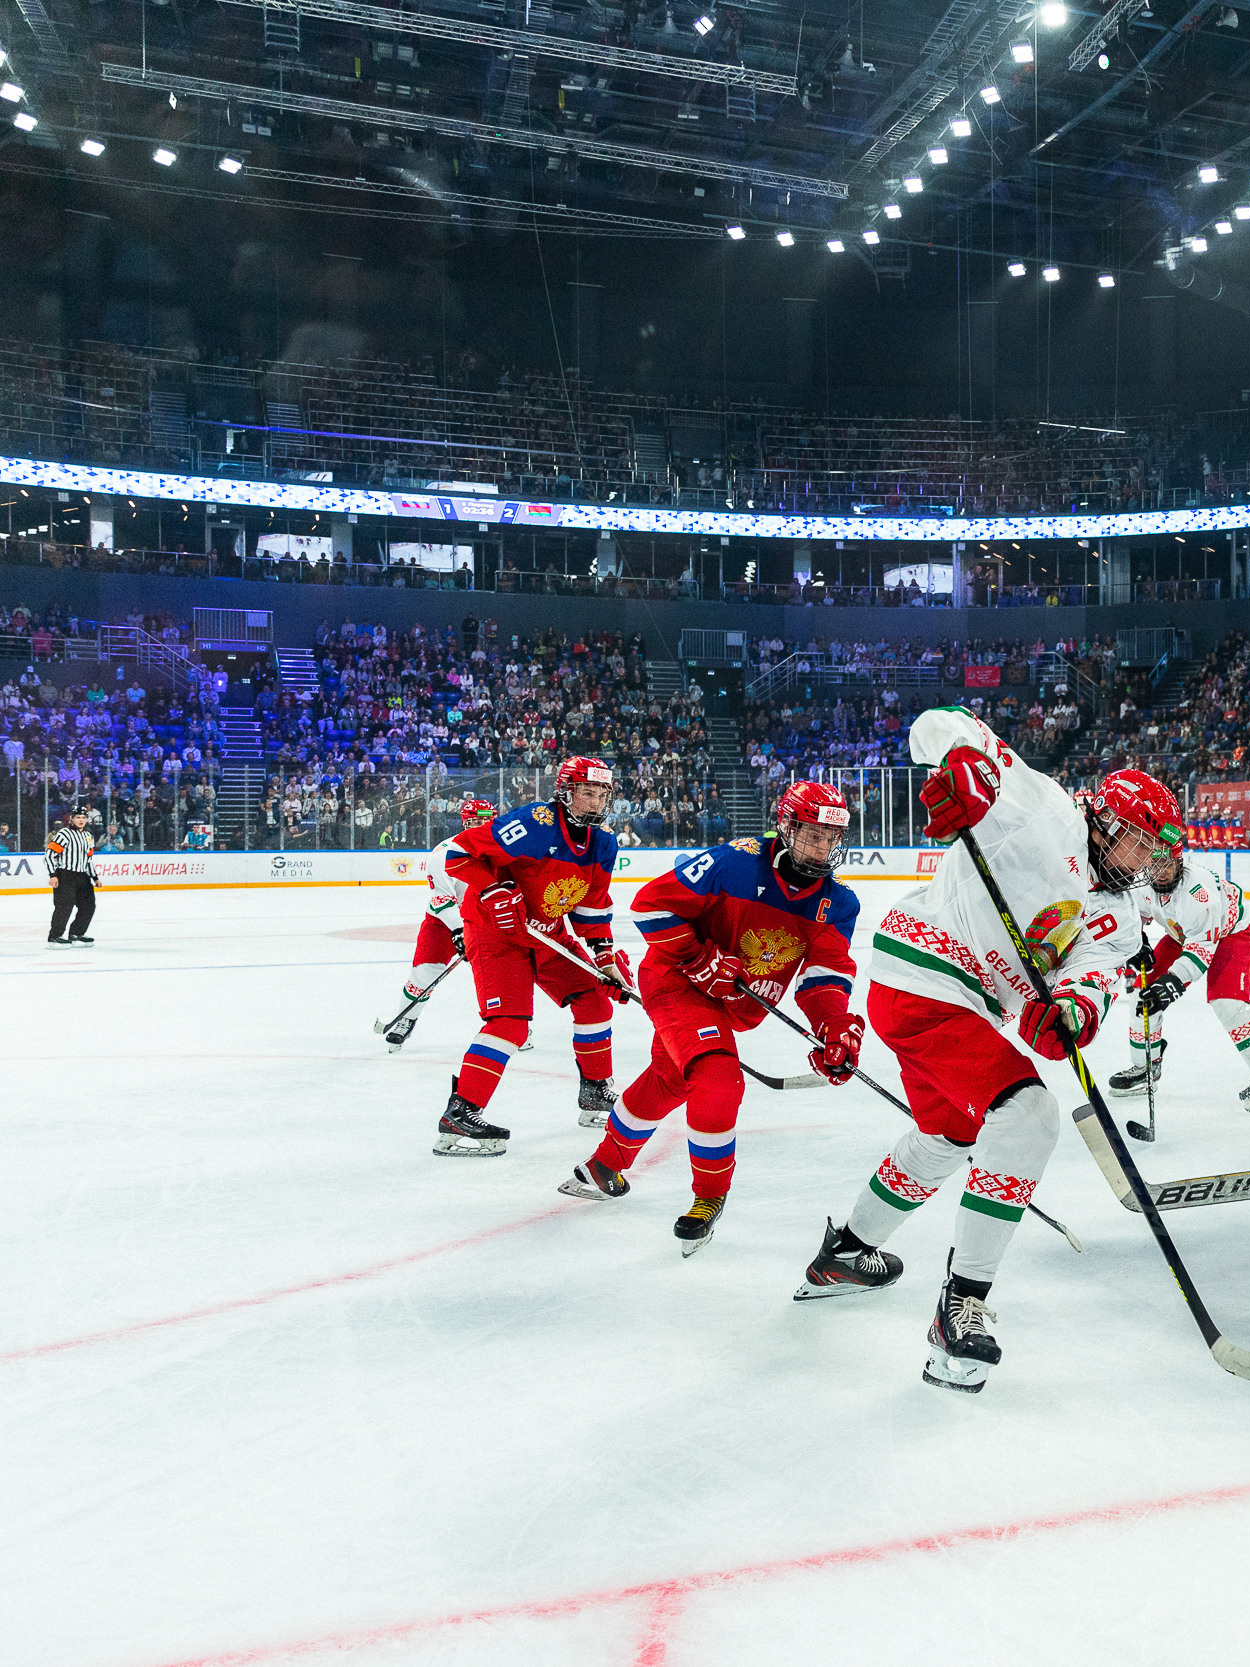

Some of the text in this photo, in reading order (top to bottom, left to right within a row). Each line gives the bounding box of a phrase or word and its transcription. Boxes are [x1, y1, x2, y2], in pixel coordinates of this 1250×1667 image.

[444, 504, 451, 514] 1
[462, 507, 494, 515] 02:36
[504, 508, 514, 517] 2
[826, 808, 840, 816] RED
[498, 819, 528, 846] 19
[132, 863, 187, 876] МАШИНА
[272, 856, 313, 869] GRAND
[816, 898, 831, 923] C
[1001, 912, 1028, 959] SUPER
[1086, 913, 1118, 941] A
[985, 949, 1040, 1001] BELARU
[749, 979, 784, 1003] СИЯ
